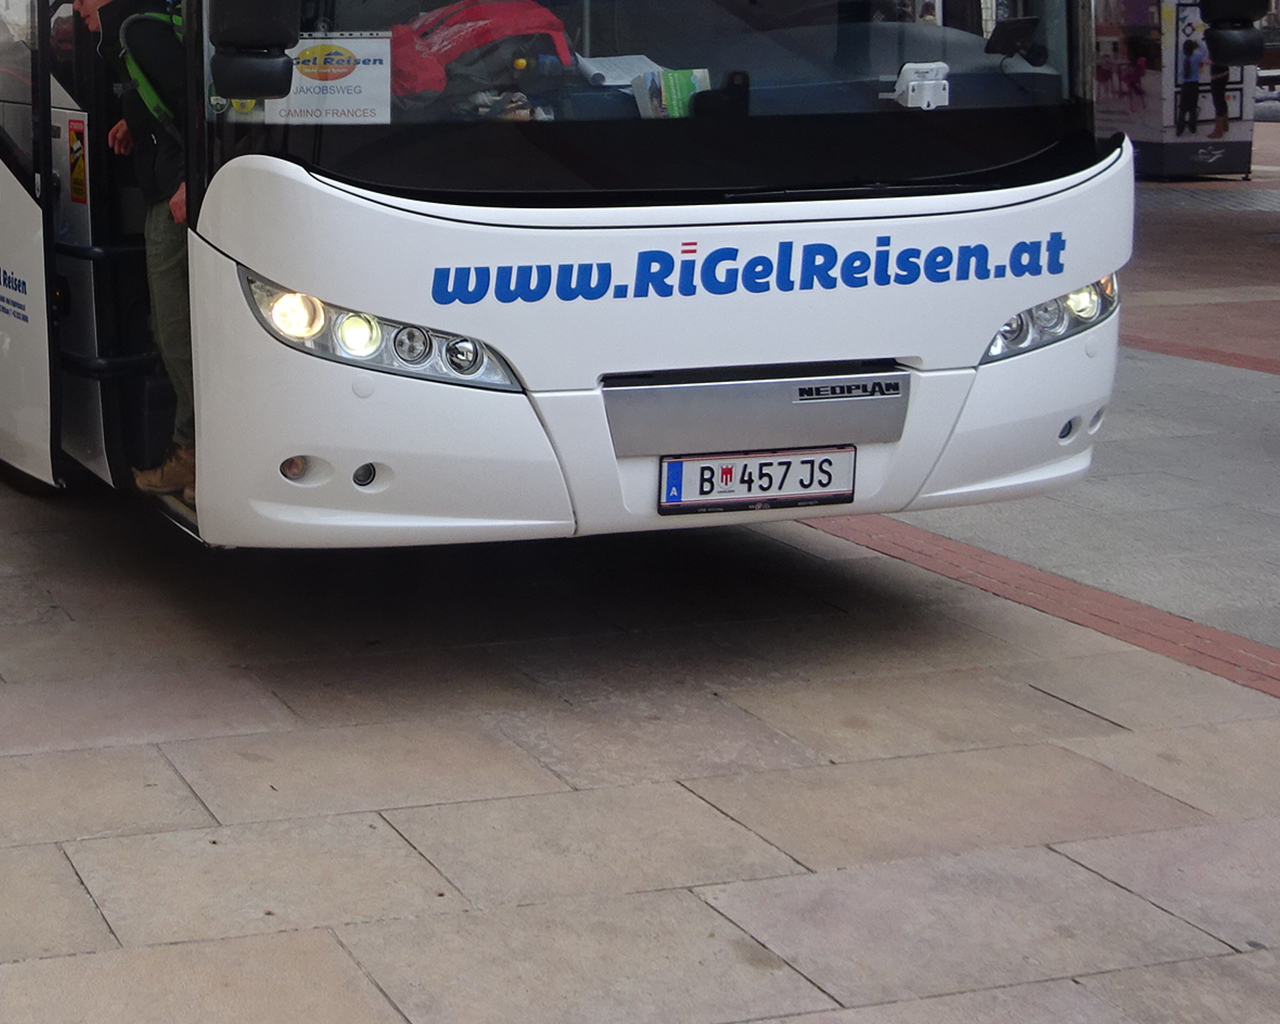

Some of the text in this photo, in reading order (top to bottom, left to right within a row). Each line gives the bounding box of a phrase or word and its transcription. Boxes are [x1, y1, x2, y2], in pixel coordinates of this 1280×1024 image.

[293, 57, 384, 65] Gel Reisen
[293, 85, 362, 94] JAKOBSWEG
[279, 108, 377, 117] CAMINO FRANCES
[430, 231, 1067, 305] www.RiGelReisen.at
[3, 270, 27, 295] Reisen
[798, 382, 901, 398] NEOPLAN
[669, 486, 679, 497] A
[699, 466, 716, 495] B
